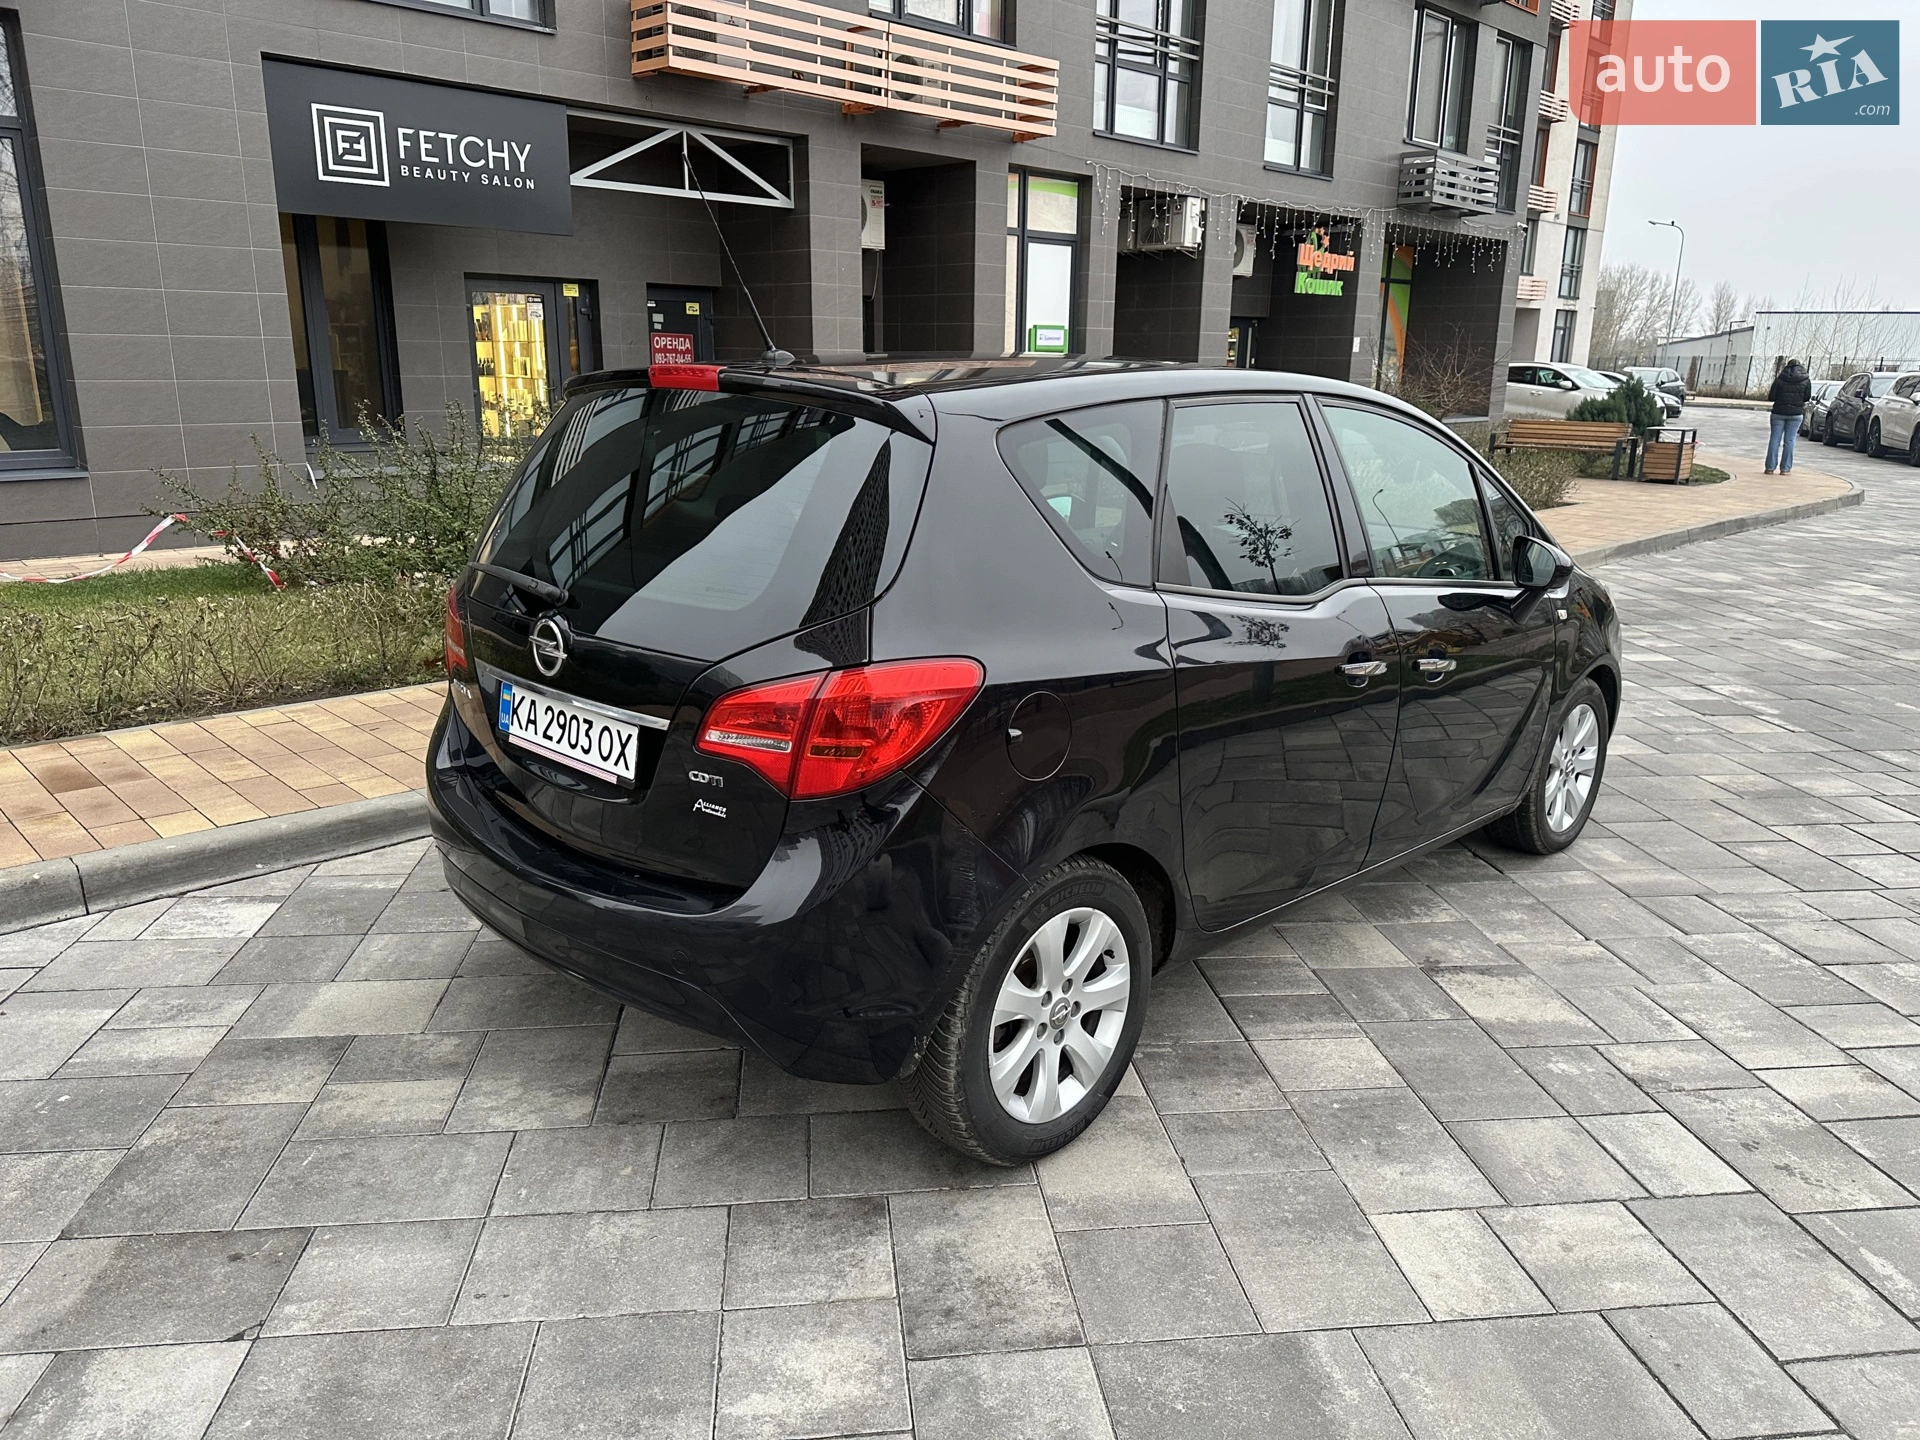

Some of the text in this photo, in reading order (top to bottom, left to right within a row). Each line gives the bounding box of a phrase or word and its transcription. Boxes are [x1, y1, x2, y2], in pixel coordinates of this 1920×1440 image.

[397, 127, 531, 172] FETCHY
[401, 165, 535, 189] BEAUTY SALON
[1297, 243, 1355, 274] Щедрий
[1294, 272, 1343, 296] Кошик
[653, 336, 691, 351] ОРЕНДА
[511, 692, 633, 771] KA 2903 OX
